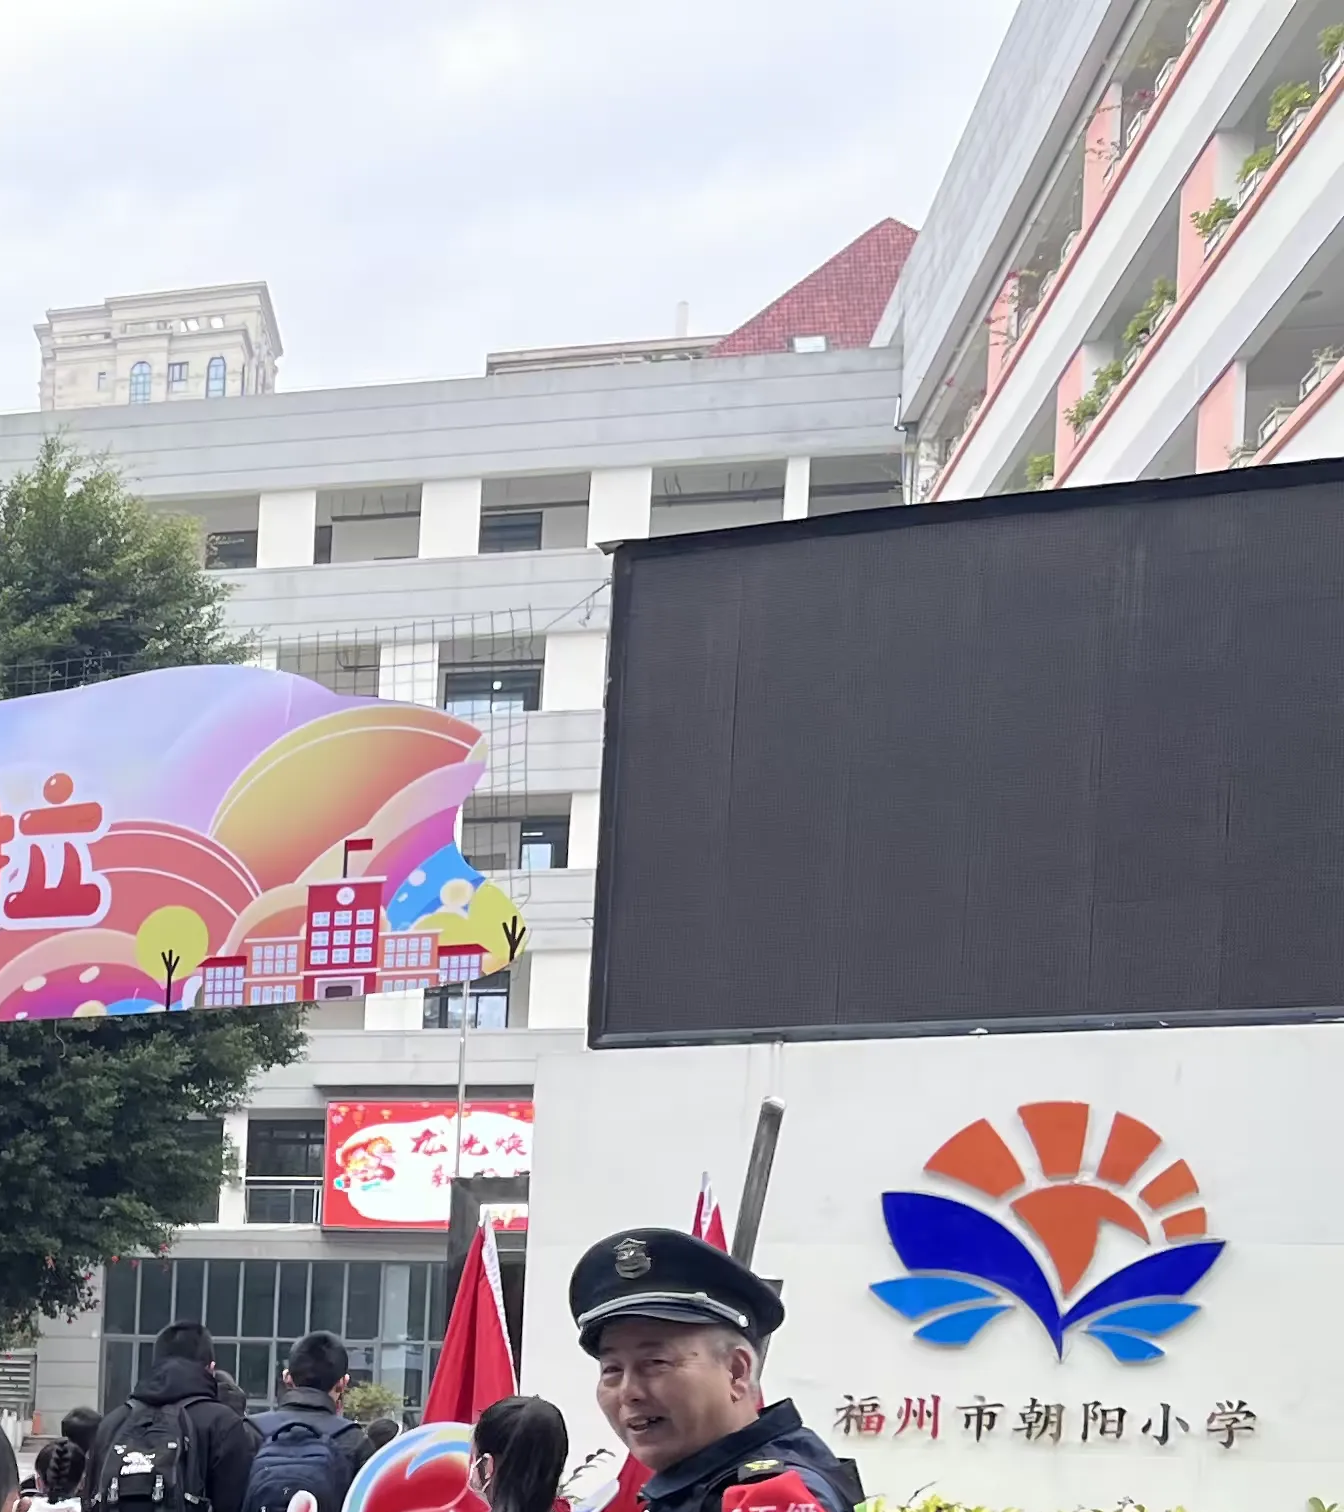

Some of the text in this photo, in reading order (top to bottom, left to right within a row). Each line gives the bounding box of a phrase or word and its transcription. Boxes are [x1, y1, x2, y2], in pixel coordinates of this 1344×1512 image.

[834, 1393, 1259, 1450] 福州市朝阳小学
